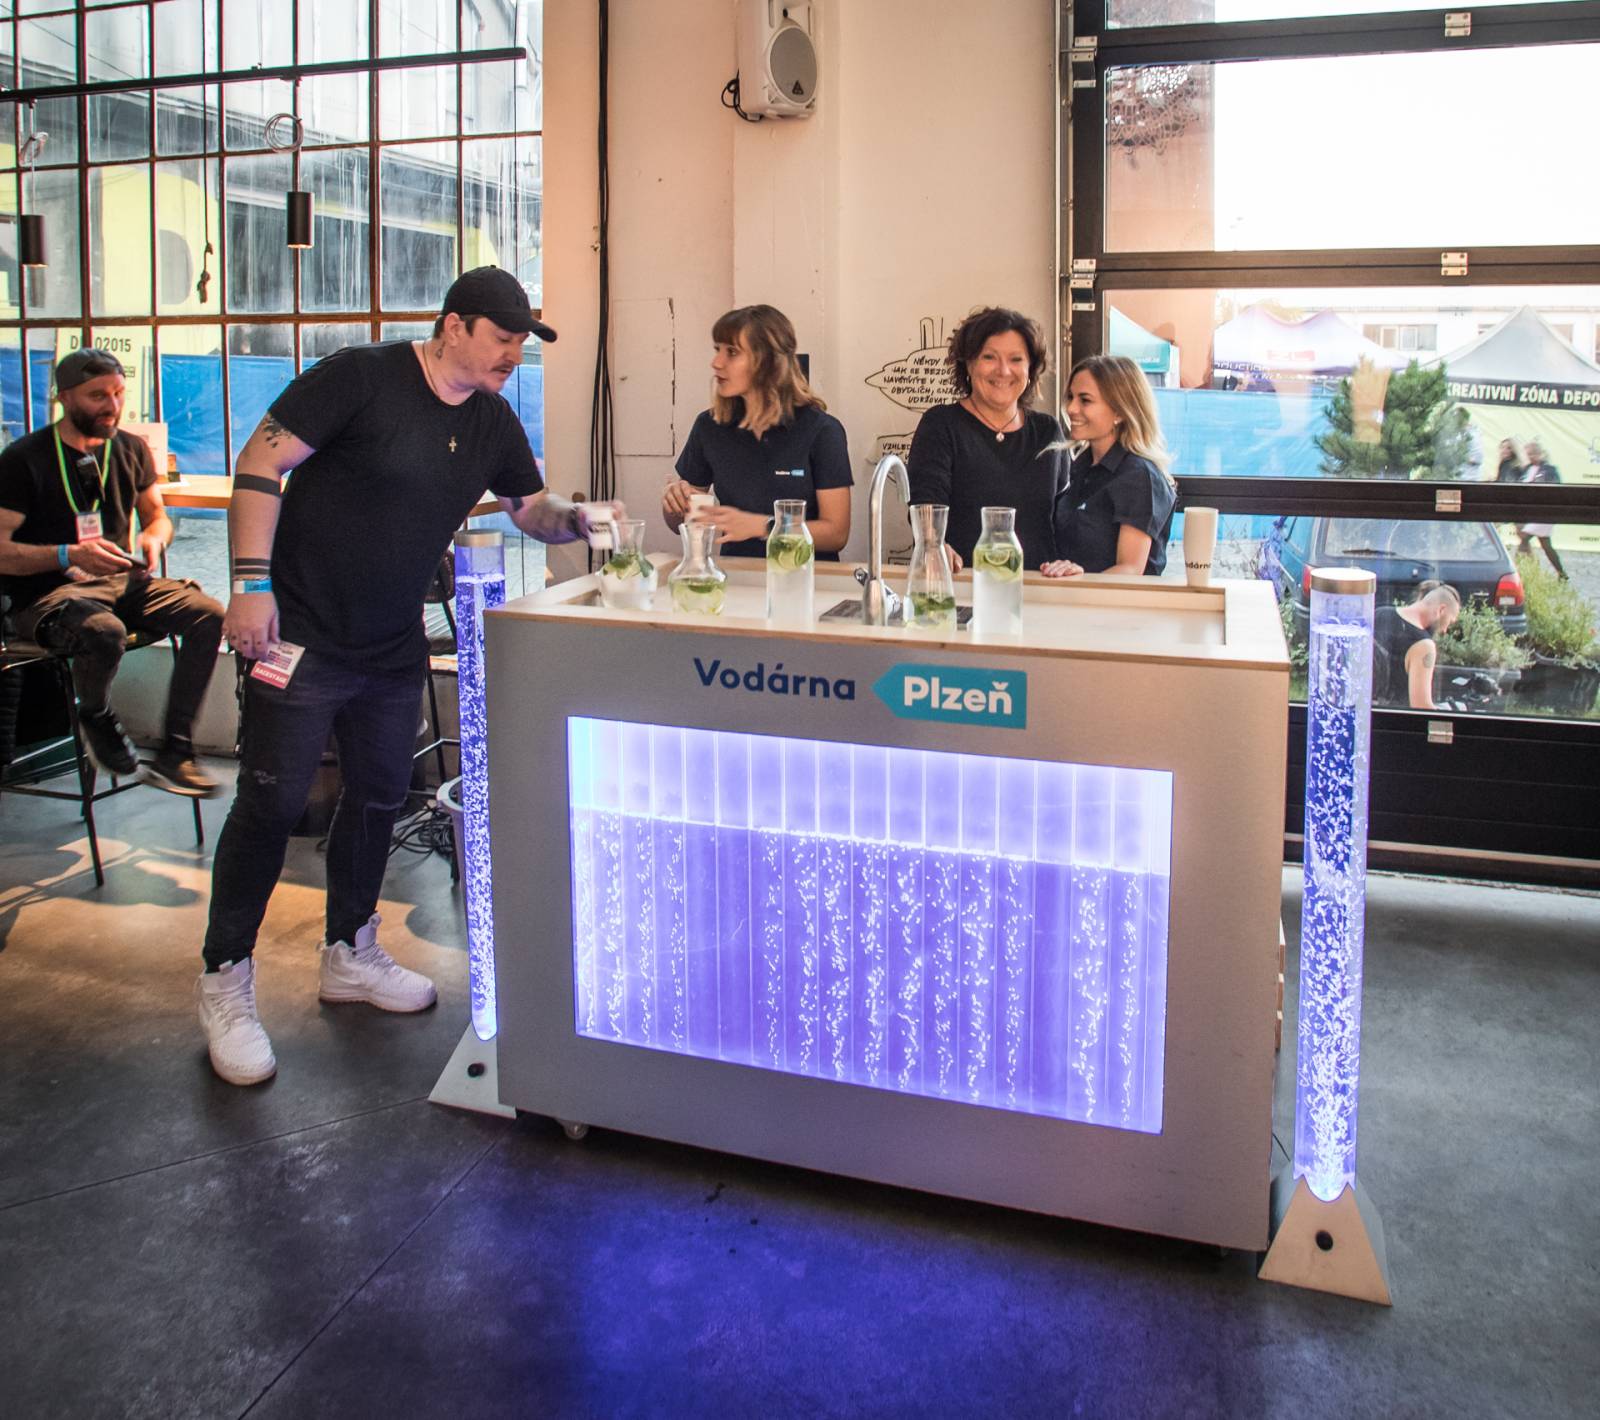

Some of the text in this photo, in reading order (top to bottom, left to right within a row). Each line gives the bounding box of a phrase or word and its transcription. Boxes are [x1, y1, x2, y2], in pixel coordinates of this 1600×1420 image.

[70, 335, 132, 352] DO2015
[1519, 384, 1559, 404] ZÓNA
[694, 657, 1013, 715] Vodárna Plzeň
